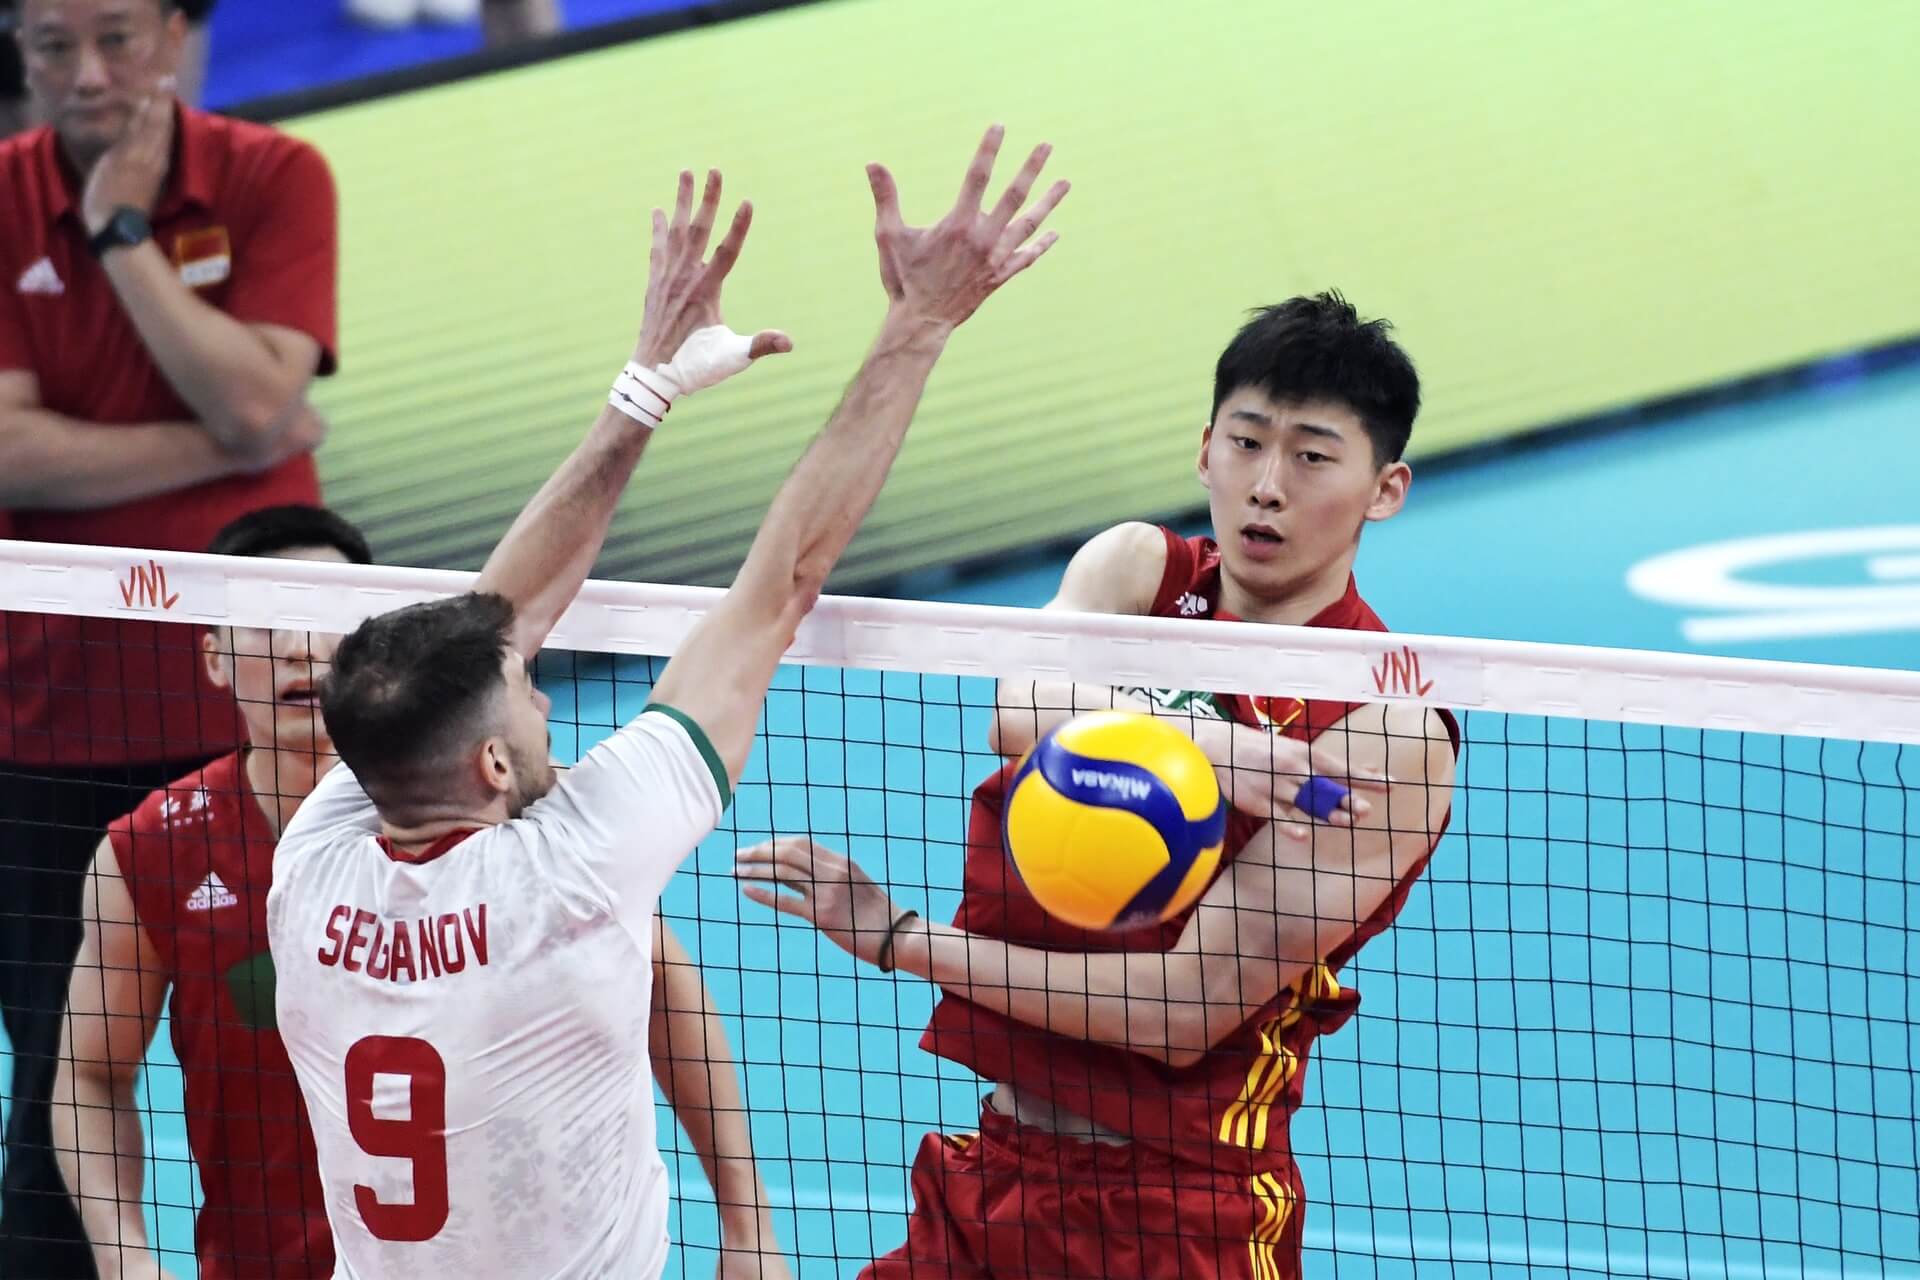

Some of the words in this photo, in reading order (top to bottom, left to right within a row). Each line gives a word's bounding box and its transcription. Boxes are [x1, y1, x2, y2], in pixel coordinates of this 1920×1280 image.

[119, 560, 180, 609] VNL
[1372, 645, 1433, 696] VNL
[318, 904, 488, 982] SEGANOV
[345, 1035, 449, 1242] 9
